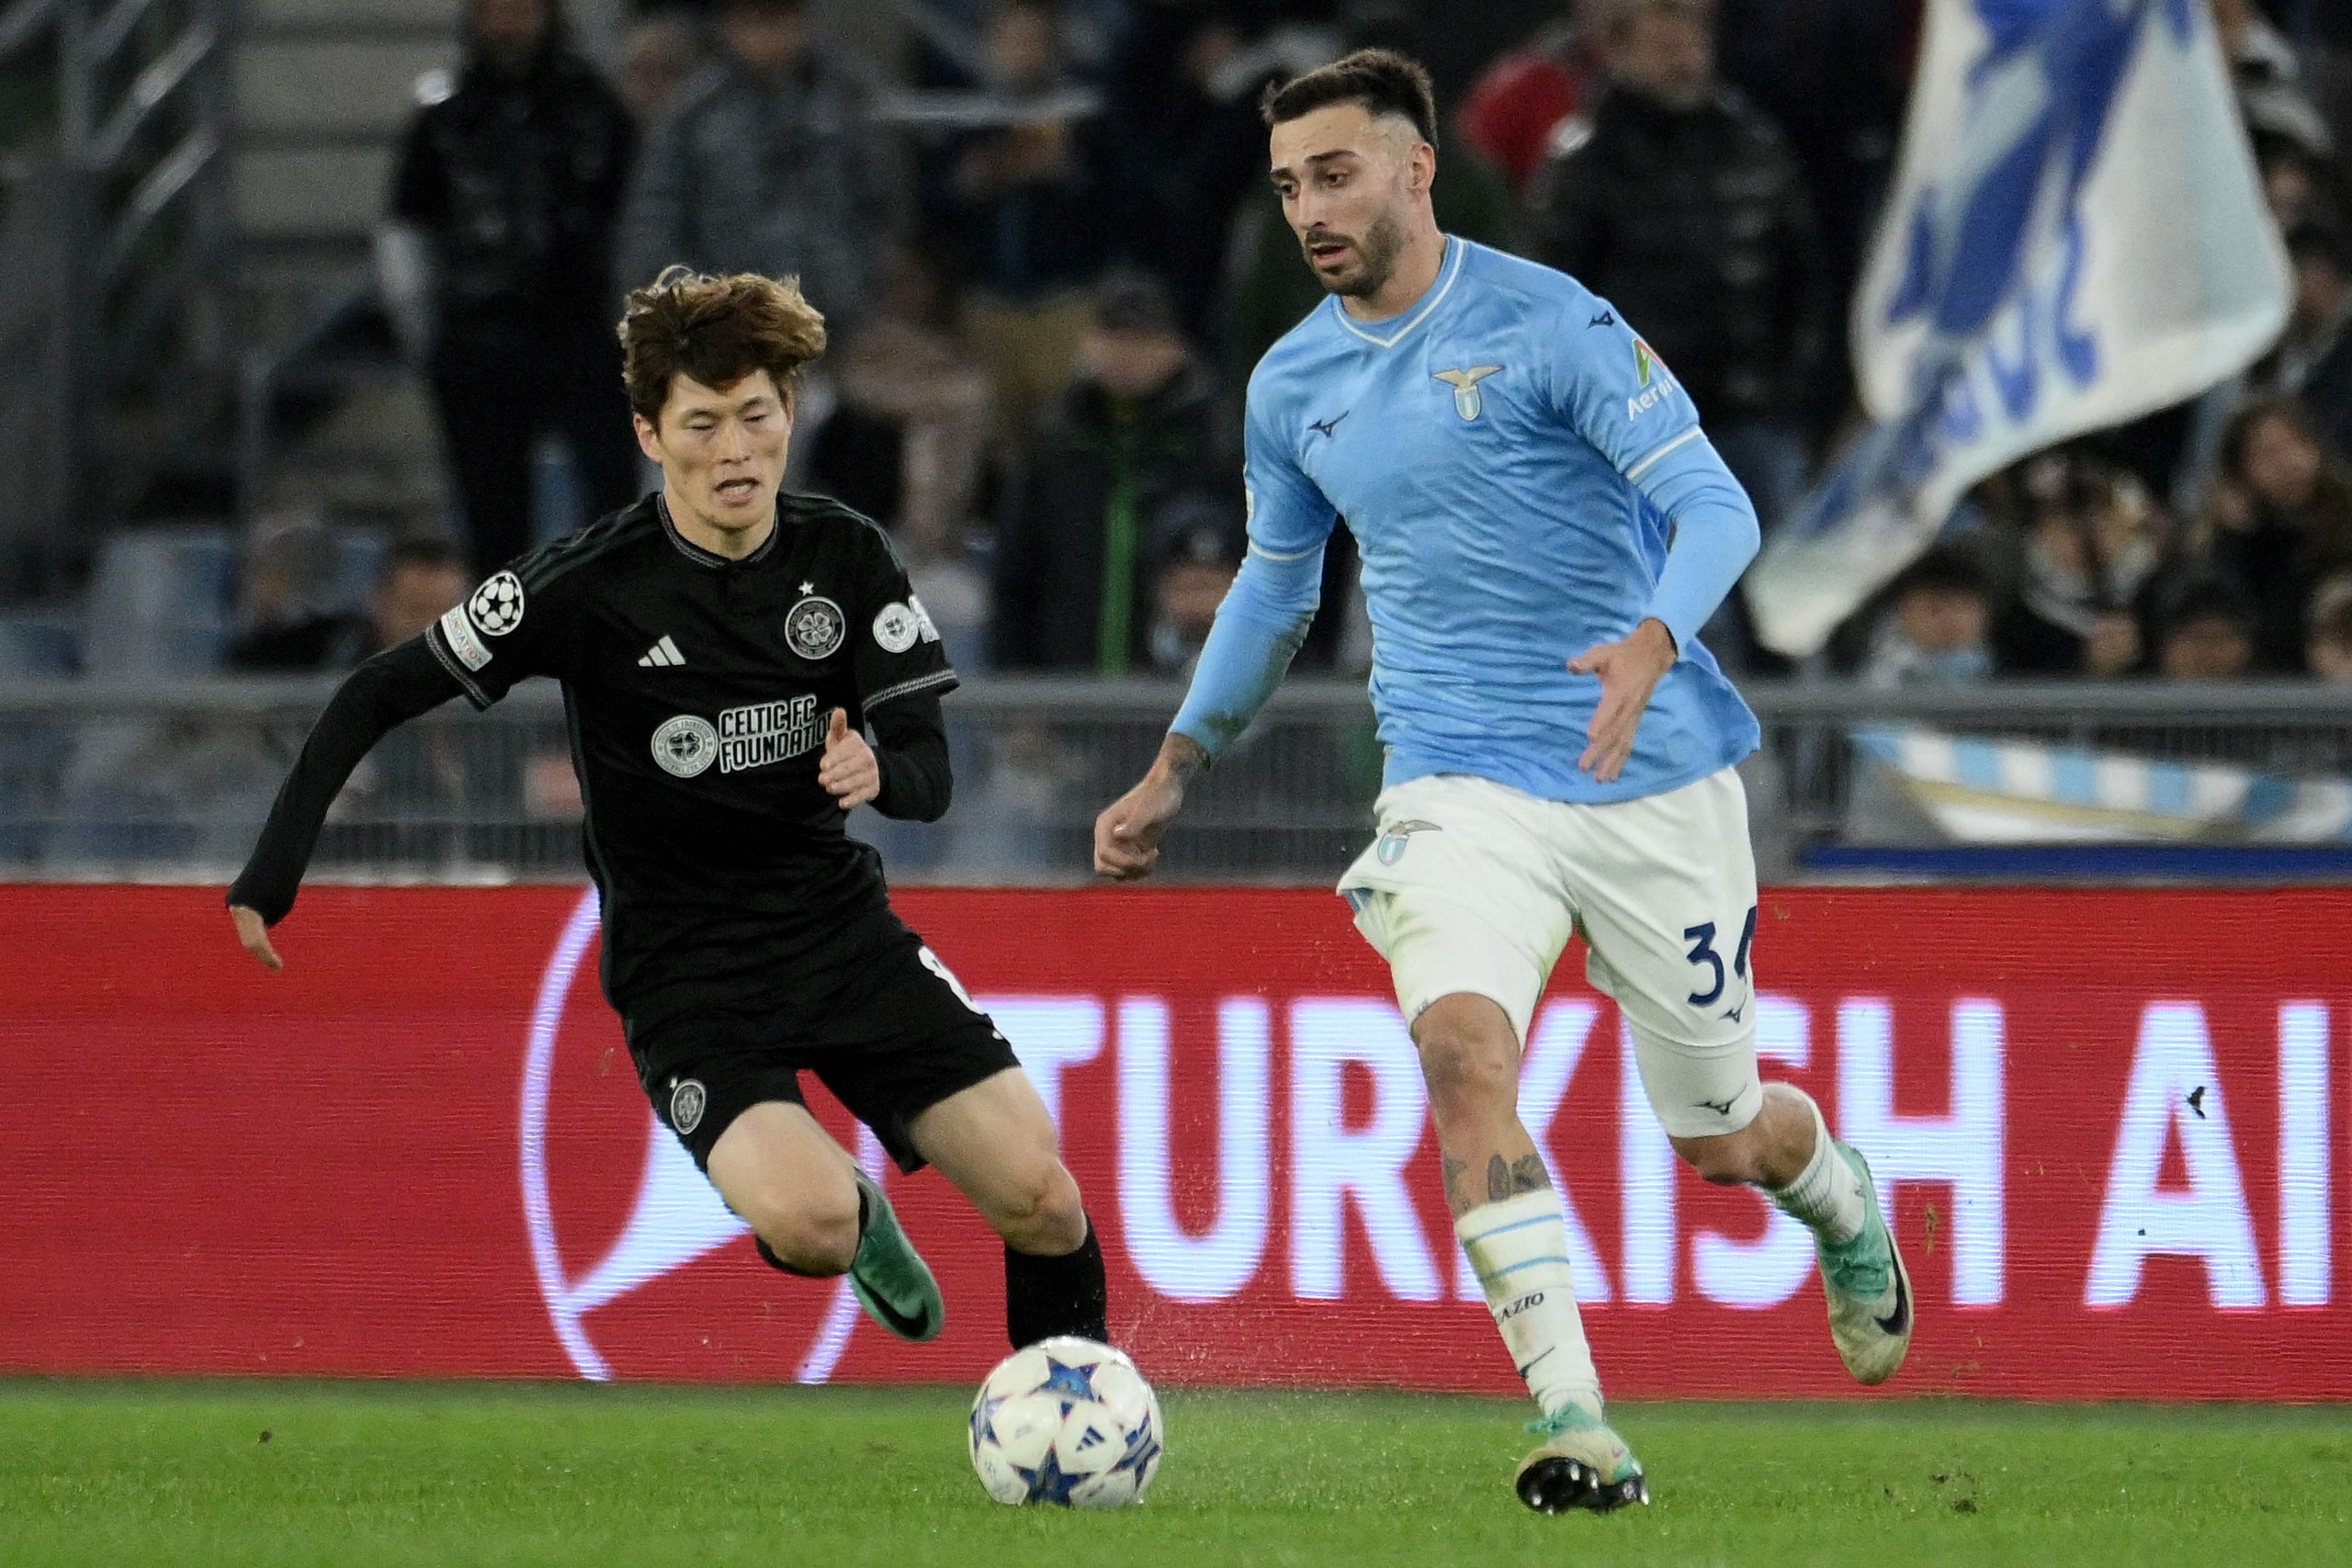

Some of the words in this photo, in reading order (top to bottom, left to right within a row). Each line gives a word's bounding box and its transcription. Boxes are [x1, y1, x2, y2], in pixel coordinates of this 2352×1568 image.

[719, 701, 787, 739] CELTIC
[791, 695, 816, 728] FC
[720, 712, 831, 773] FOUNDATIO
[2083, 999, 2331, 1308] AI
[1498, 1292, 1544, 1324] AZIO
